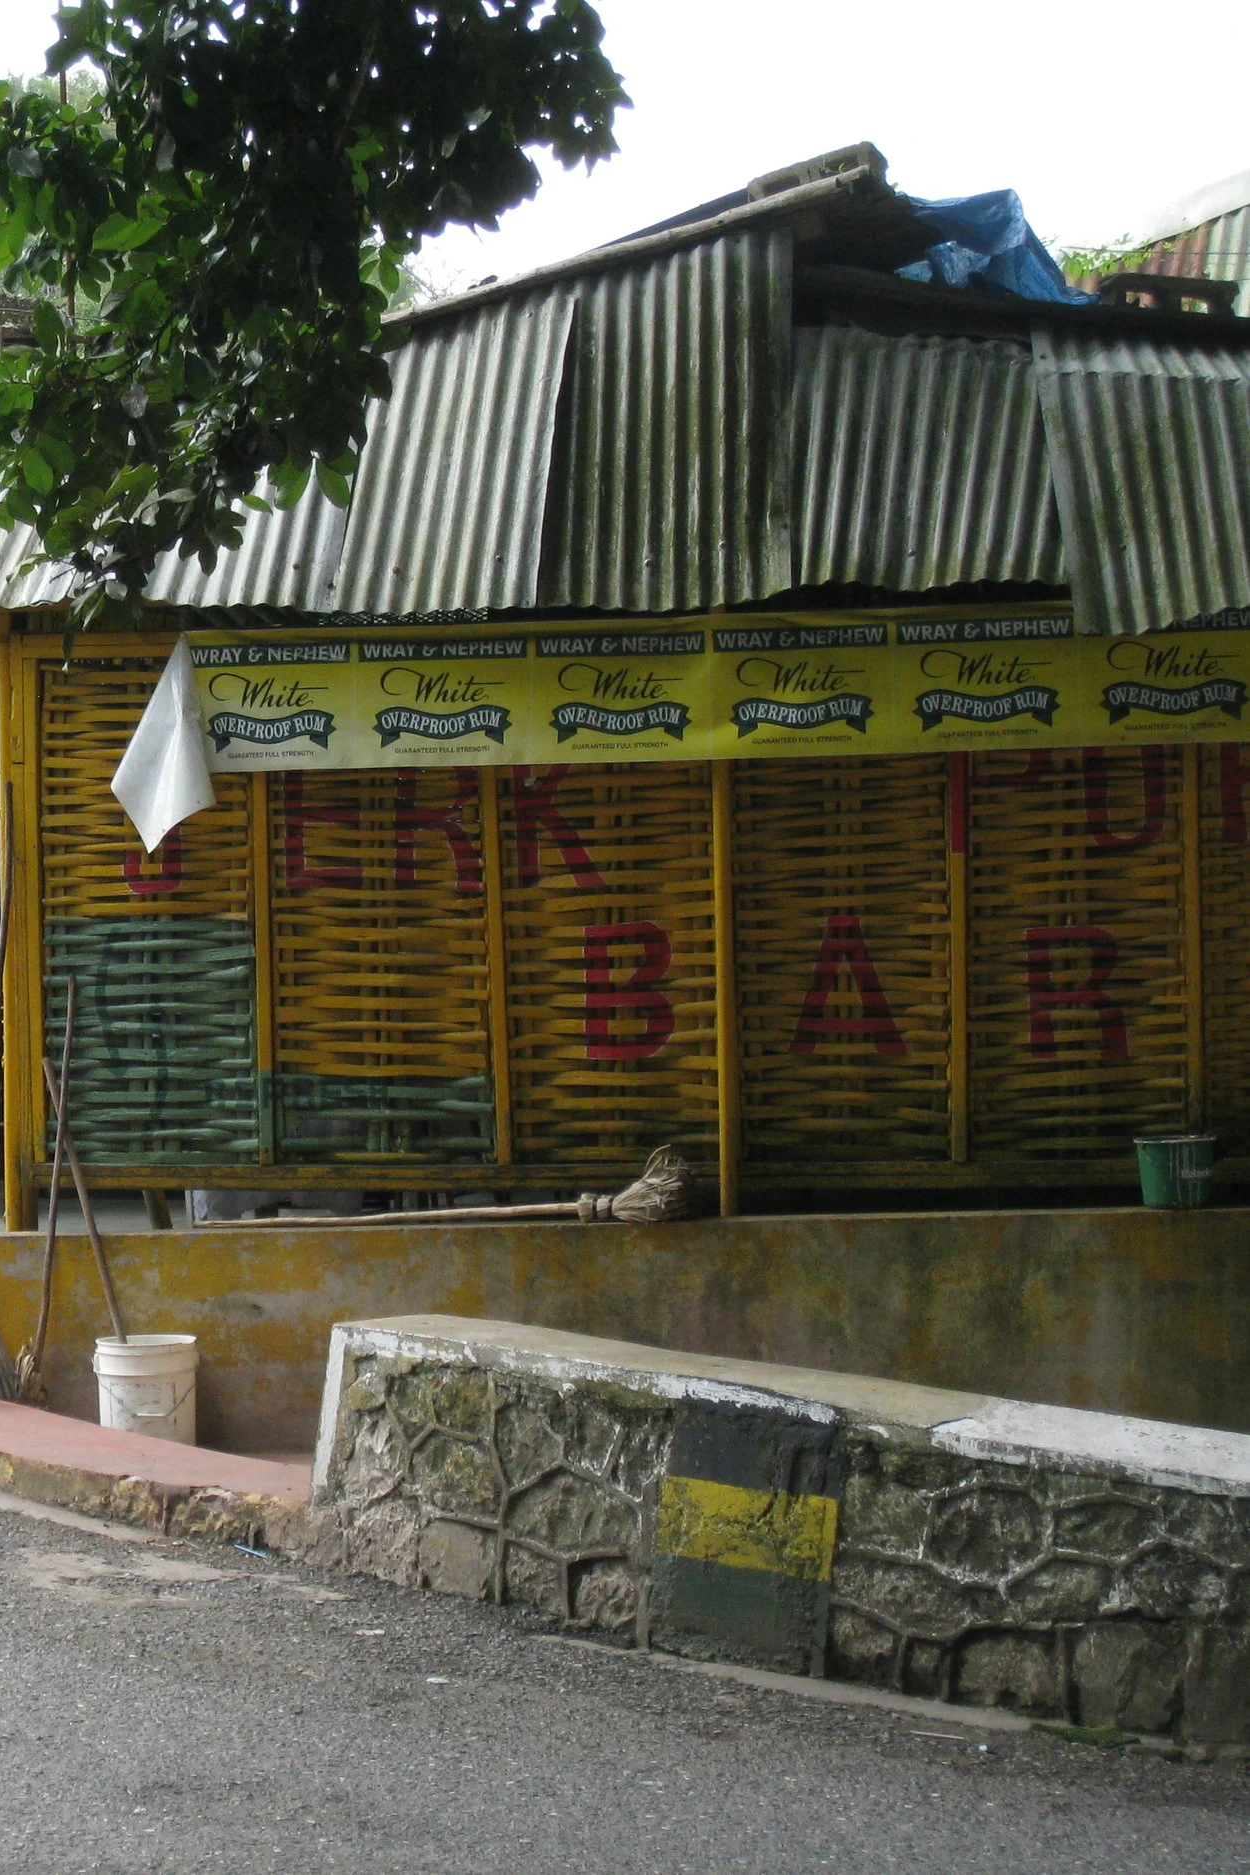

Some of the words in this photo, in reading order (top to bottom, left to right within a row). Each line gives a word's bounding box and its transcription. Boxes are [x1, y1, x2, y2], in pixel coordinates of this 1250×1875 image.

[716, 631, 773, 648] WRAY
[779, 631, 795, 647] &
[801, 627, 883, 645] NEPHEW
[901, 624, 957, 641] WRAY
[964, 623, 980, 638] &
[985, 618, 1070, 637] NEPHEW
[191, 648, 243, 664] WRAY
[249, 647, 263, 662] &
[268, 645, 347, 661] NEPHEW
[363, 643, 417, 658] WRAY
[422, 643, 437, 656] &
[443, 641, 523, 656] NEPHEW
[541, 638, 596, 653] WRAY
[601, 637, 617, 652] &
[622, 635, 701, 652] NEPHEW
[920, 649, 1051, 685] White
[1107, 641, 1240, 677] White
[380, 667, 505, 703] White
[558, 663, 683, 699] White
[736, 657, 865, 693] White
[209, 672, 329, 708] White
[1109, 686, 1199, 710] OVERPROOF
[1203, 684, 1238, 702] RUM
[738, 702, 827, 725] OVERPROOF
[829, 699, 863, 717] RUM
[922, 693, 1011, 717] OVERPROOF
[1014, 691, 1049, 709] RUM
[214, 716, 291, 739] OVERPROOF
[295, 714, 327, 733] RUM
[382, 711, 467, 735] OVERPROOF
[468, 710, 502, 728] RUM
[558, 707, 645, 731] OVERPROOF
[648, 706, 682, 725] RUM
[581, 915, 1128, 1060] BAR
